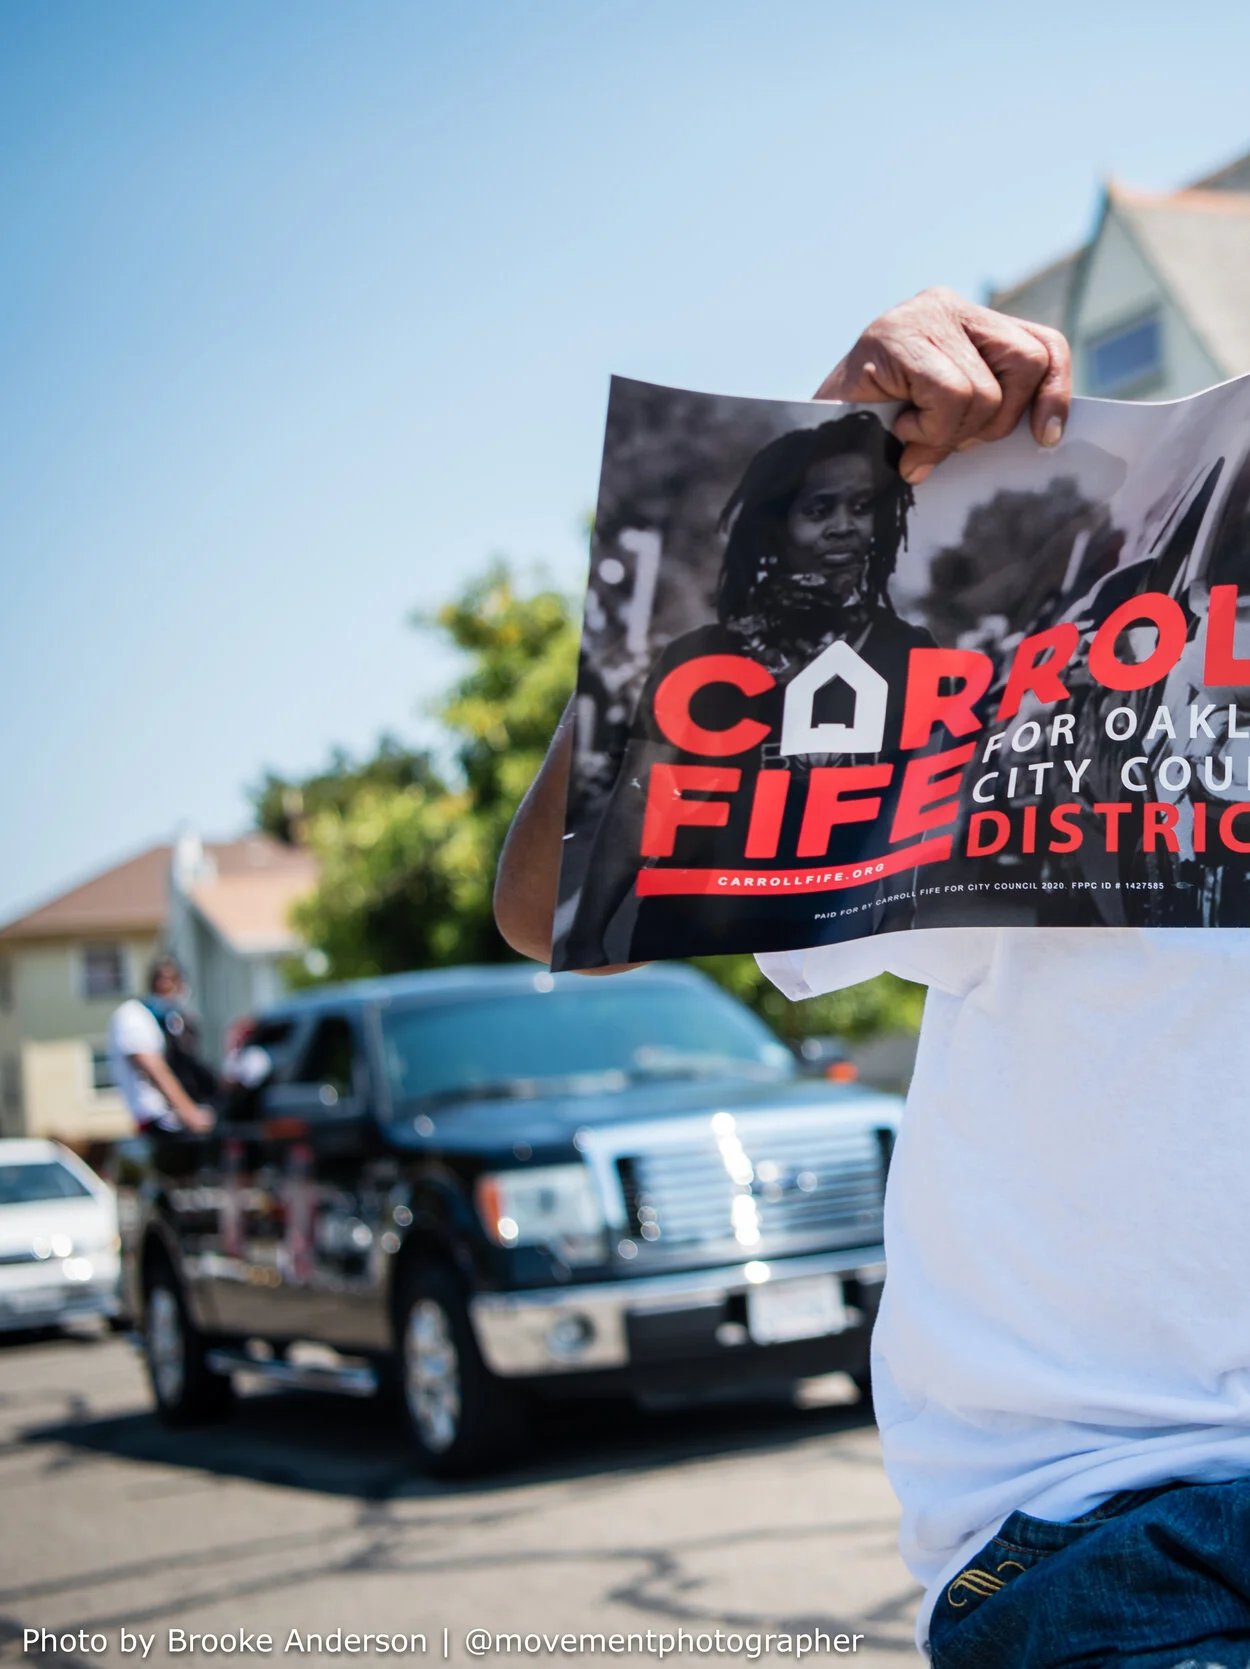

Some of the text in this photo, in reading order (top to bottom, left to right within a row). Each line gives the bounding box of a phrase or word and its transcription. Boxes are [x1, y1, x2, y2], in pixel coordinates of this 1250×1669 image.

[981, 713, 1076, 764] FOR
[639, 741, 978, 860] FIFE
[971, 757, 1093, 804] CITY
[717, 862, 885, 887] CARROLLFIFE.ORG
[814, 911, 837, 920] PAID
[840, 907, 859, 916] FOR
[861, 903, 873, 911] BY
[875, 891, 917, 906] CARROLL
[919, 887, 941, 896] FIFE
[944, 884, 964, 893] FOR
[967, 883, 991, 891] CITY
[994, 882, 1038, 890] COUNCIL
[1071, 882, 1098, 890] FPPC
[1101, 882, 1112, 890] ID
[1125, 882, 1165, 890] 1427585
